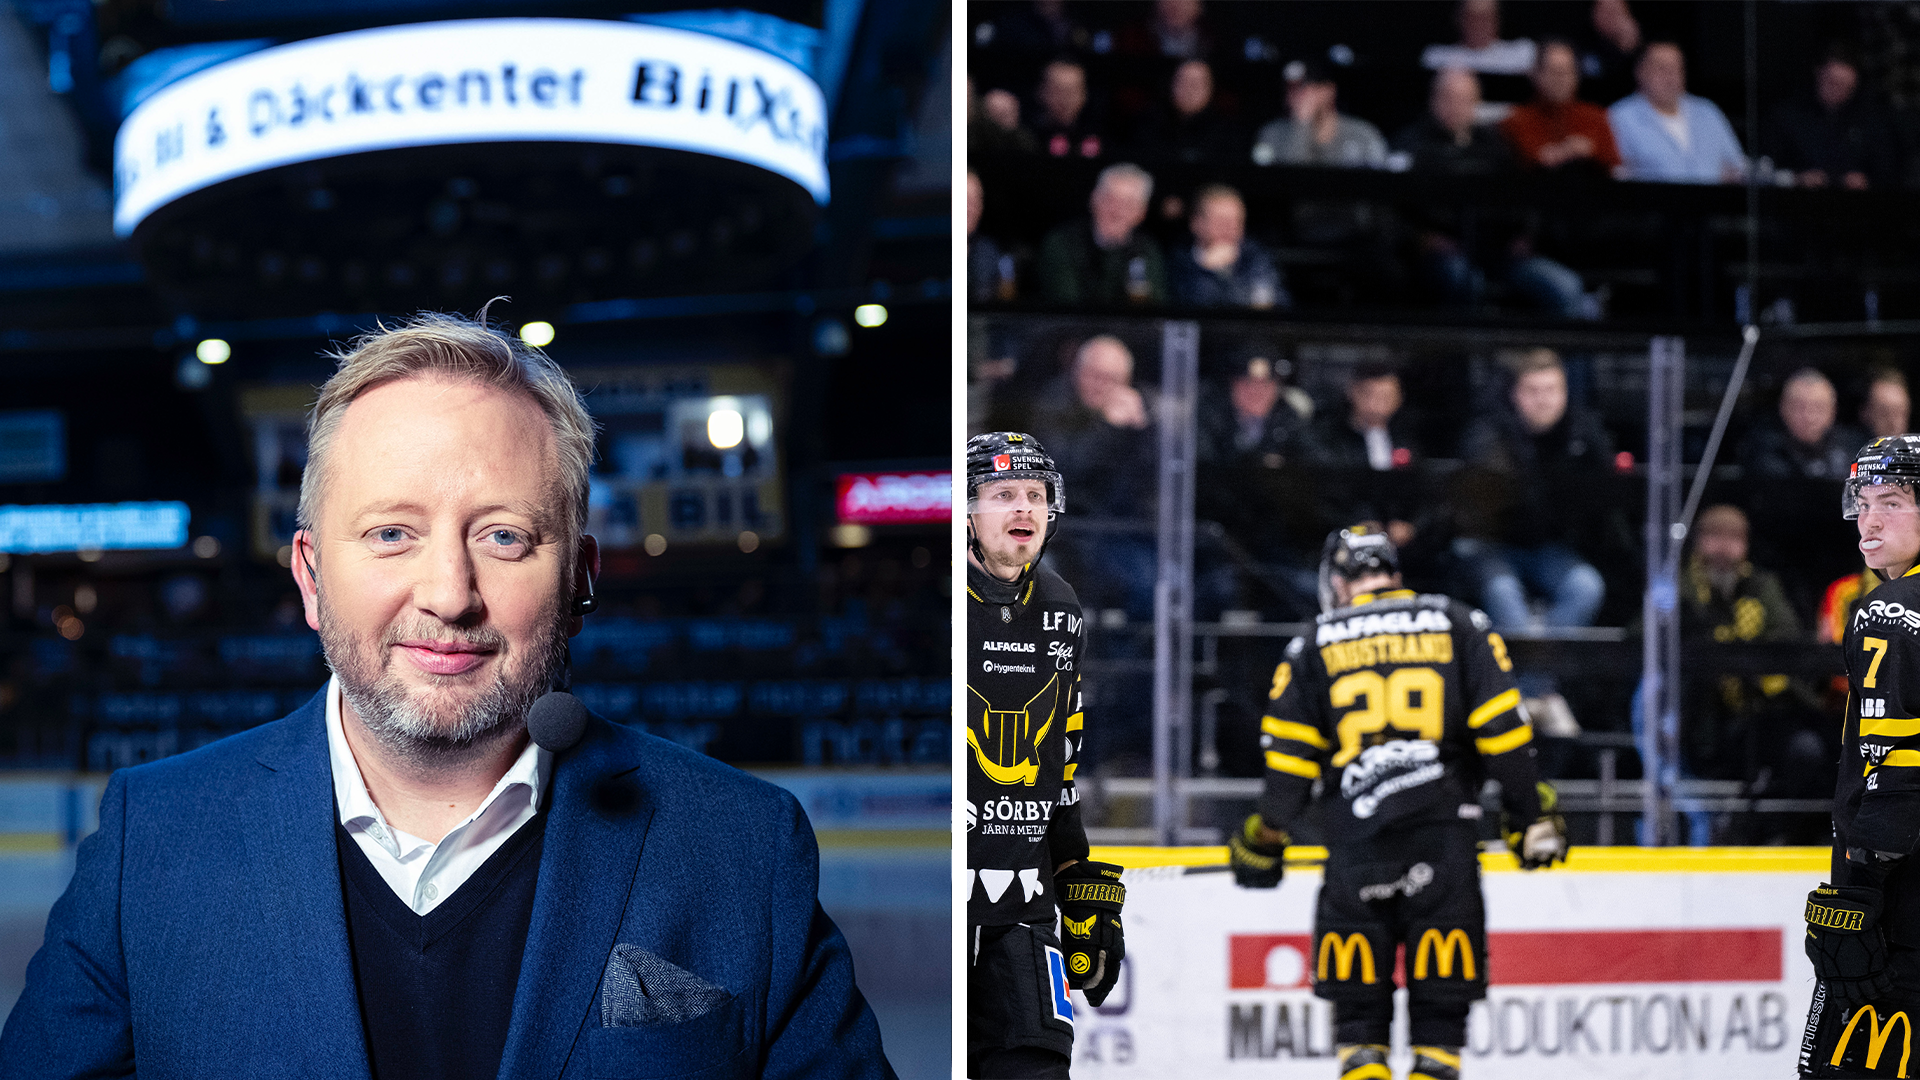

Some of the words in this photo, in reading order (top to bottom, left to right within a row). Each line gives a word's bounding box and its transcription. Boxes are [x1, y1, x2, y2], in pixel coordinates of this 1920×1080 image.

[1012, 455, 1044, 464] SVENSKA
[1013, 462, 1032, 470] SPEL
[1857, 463, 1886, 472] SVENSKA
[1042, 610, 1066, 631] LF
[1853, 599, 1920, 629] AROS
[982, 640, 1036, 653] ALFAGLAS
[993, 662, 1036, 674] Hygienteknik
[1862, 636, 1888, 689] 7
[1328, 666, 1445, 768] 29
[982, 795, 1053, 821] SÖRBY
[981, 823, 1010, 835] JÄRN
[1009, 825, 1016, 835] &
[1805, 900, 1865, 931] RRIOR
[1467, 995, 1712, 1058] ODUKTION
[1720, 991, 1791, 1056] AB
